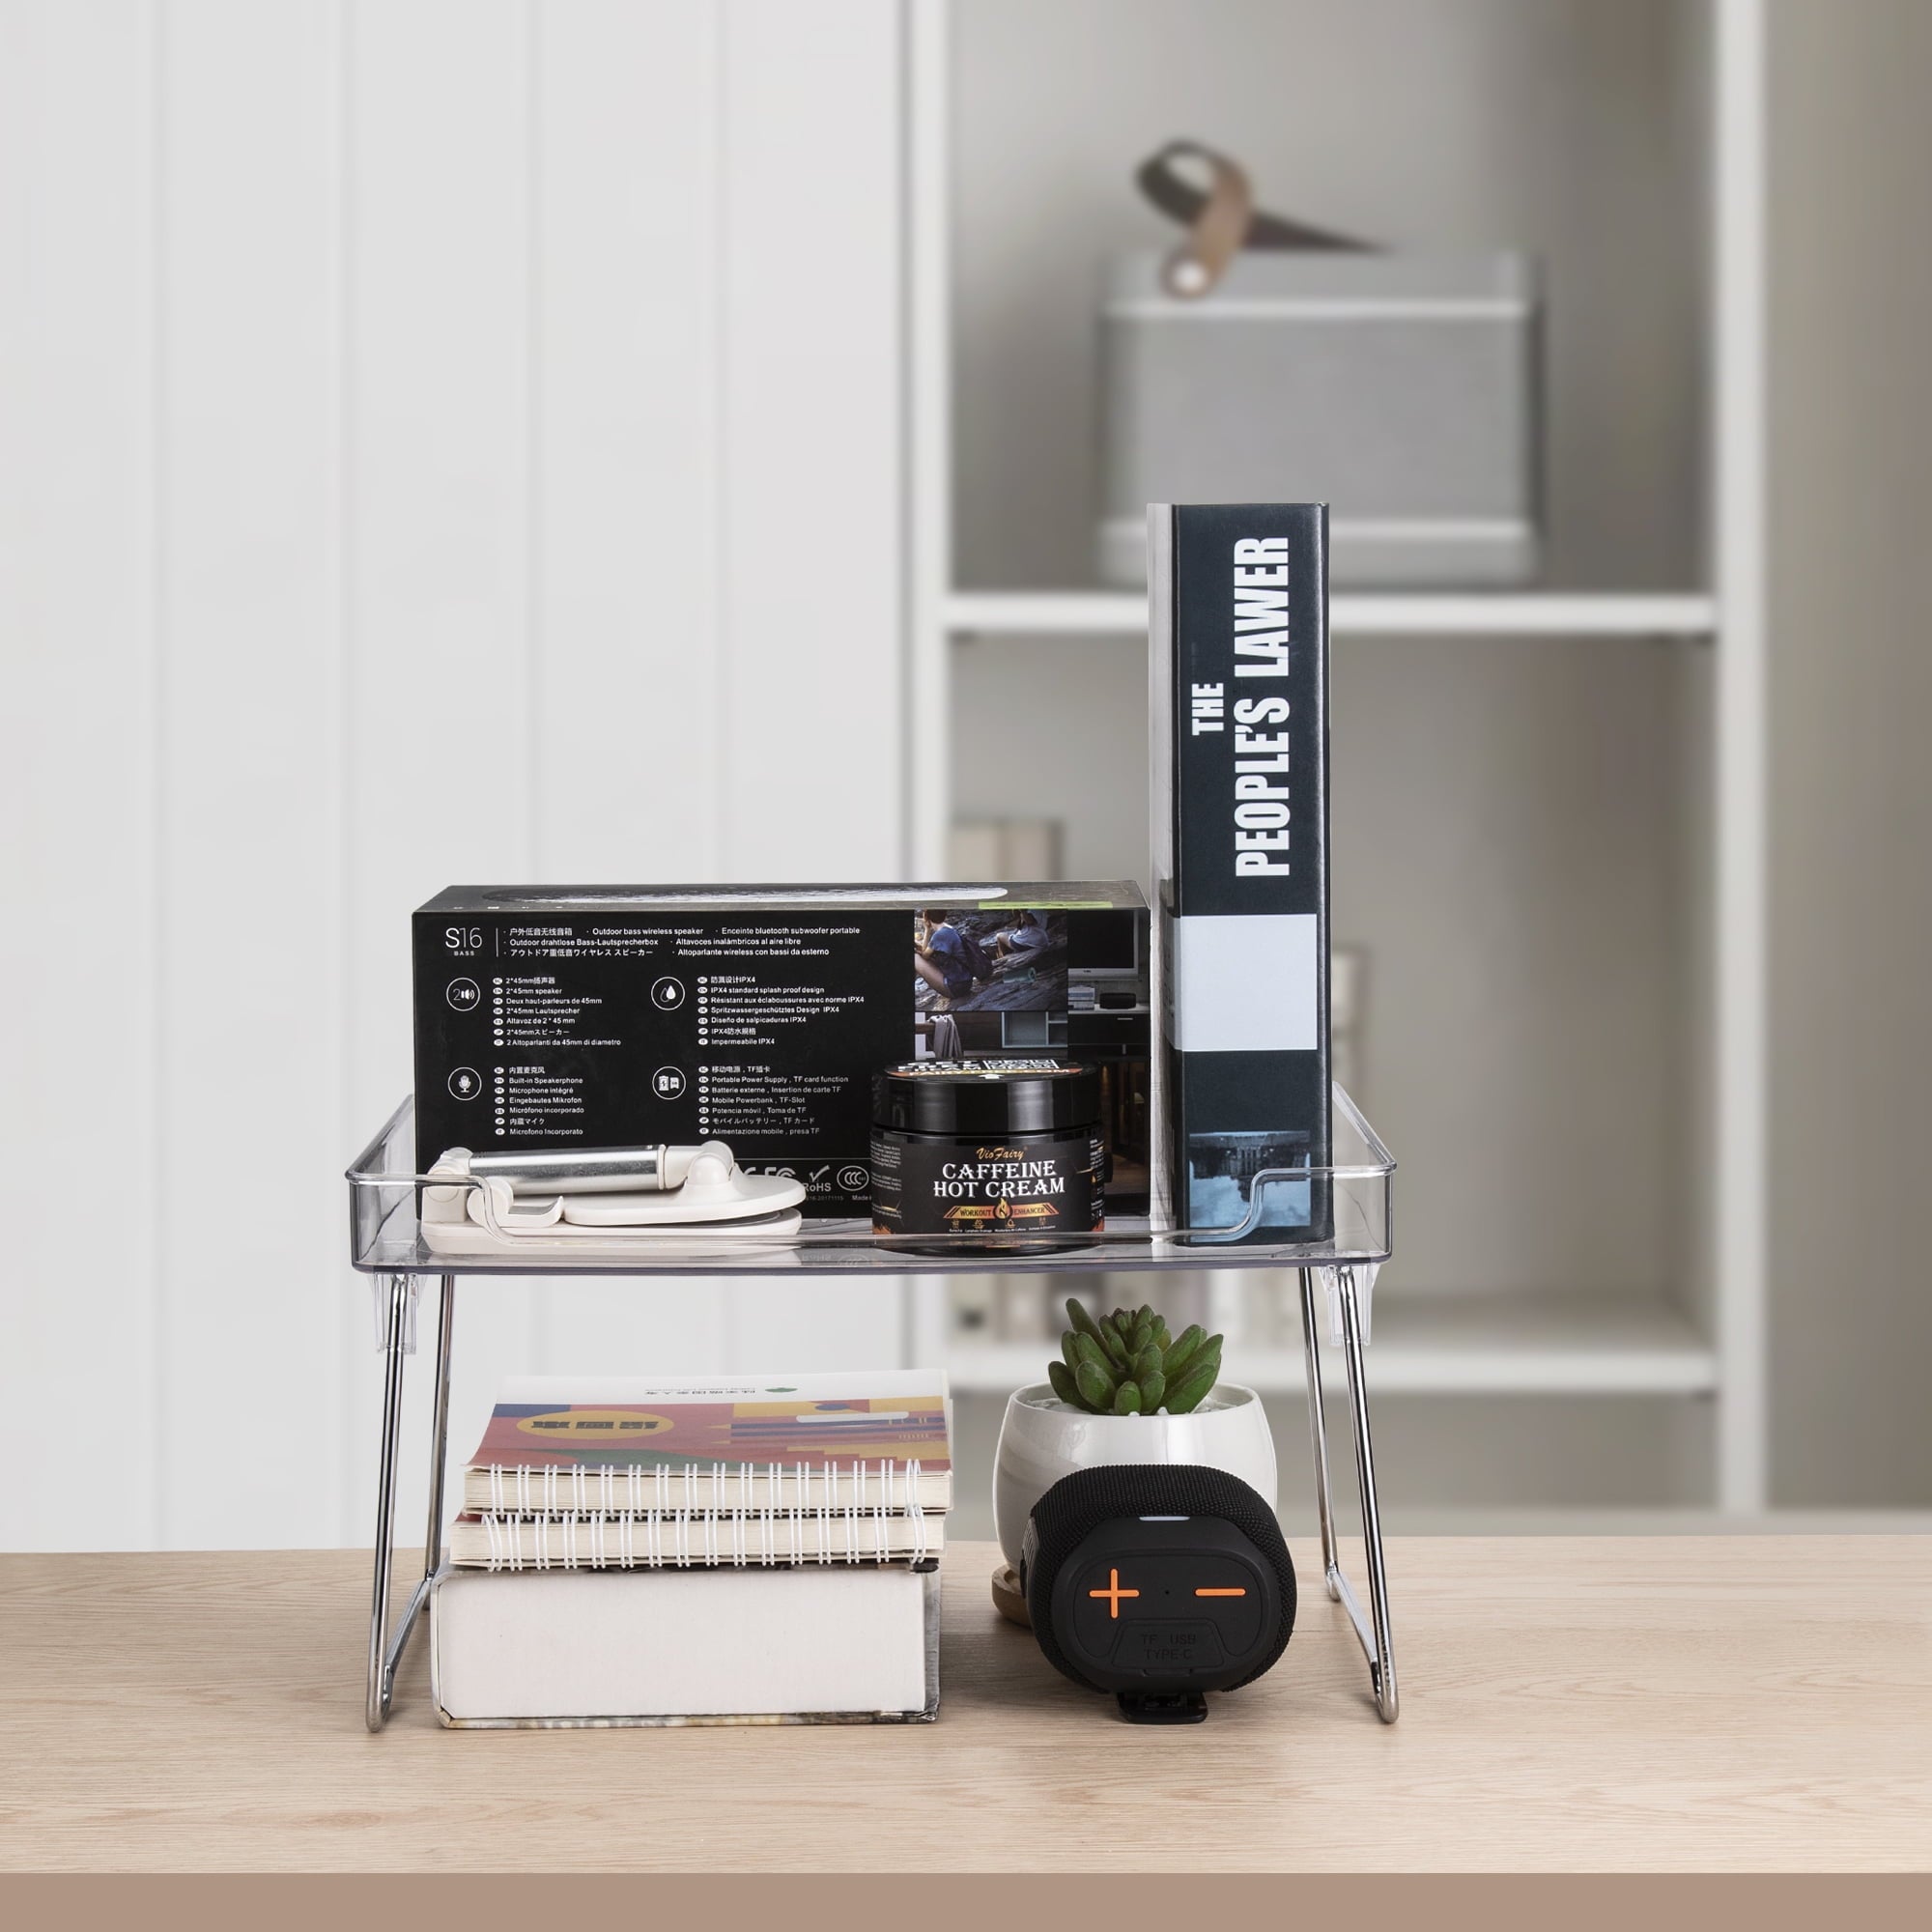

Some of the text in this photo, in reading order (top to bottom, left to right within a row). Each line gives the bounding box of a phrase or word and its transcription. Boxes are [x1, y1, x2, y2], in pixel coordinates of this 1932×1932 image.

[1191, 682, 1224, 735] THE
[1233, 537, 1291, 877] PEOPLE'S LAWER
[674, 927, 704, 936] speaker
[445, 927, 482, 949] S16
[509, 938, 659, 947] Outdoor drahtlose Bass-Lautsprecherbox
[677, 949, 723, 957] Altoparlante
[724, 948, 754, 956] wireless
[759, 986, 782, 995] splash
[802, 986, 825, 995] design
[796, 1006, 820, 1014] Design
[746, 1016, 789, 1025] salpicaduras
[509, 1087, 549, 1095] Microphone
[509, 1096, 552, 1105] Eingebautes
[976, 1147, 1024, 1160] VioFairy
[942, 1160, 1057, 1179] CAFFEINE
[802, 1182, 831, 1192] RoHS
[933, 1177, 1065, 1198] HOT CREAM
